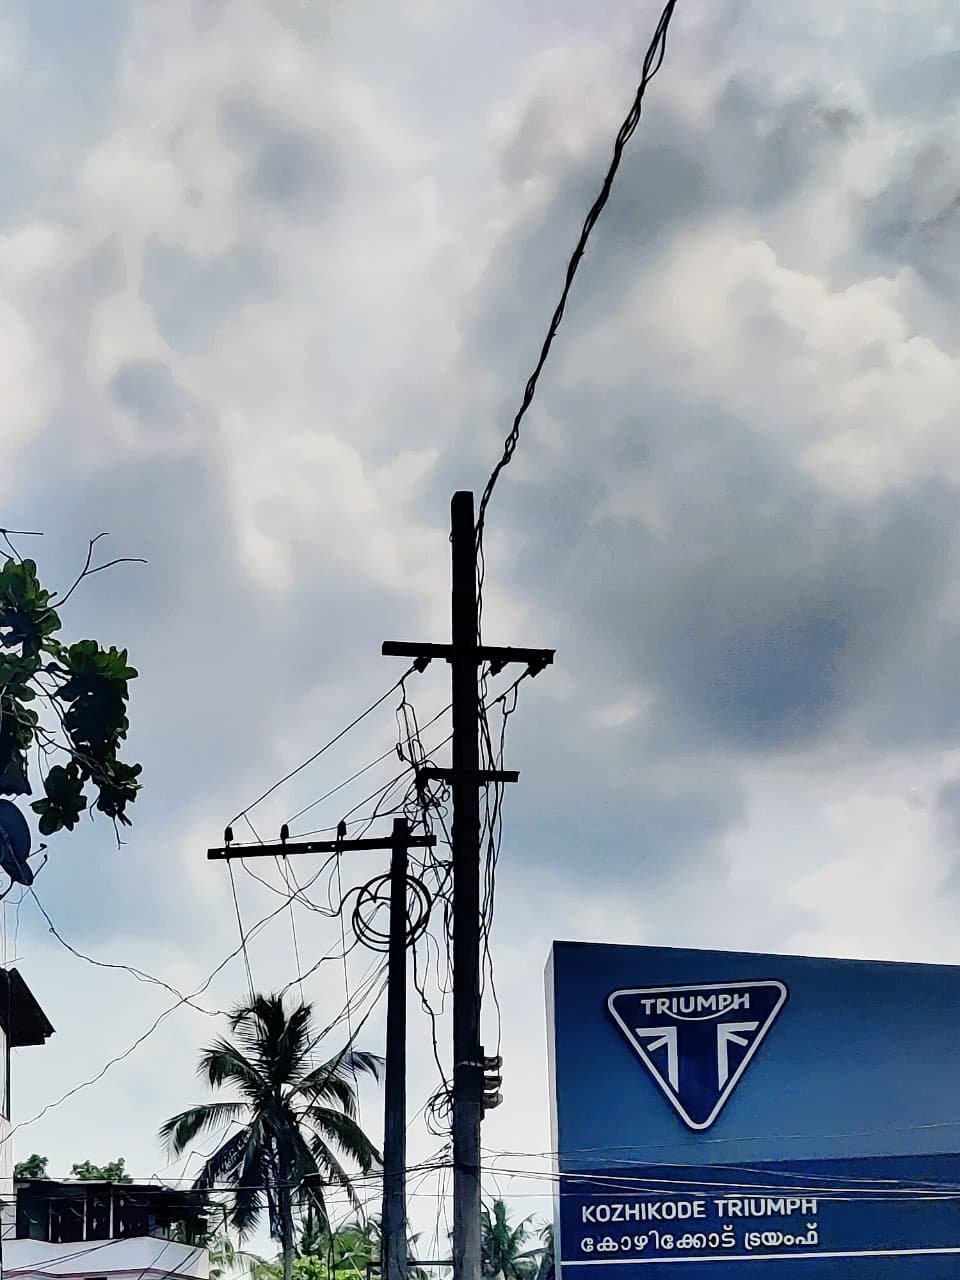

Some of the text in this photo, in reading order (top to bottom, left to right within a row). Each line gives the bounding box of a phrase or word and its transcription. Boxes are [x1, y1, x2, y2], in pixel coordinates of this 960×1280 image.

[640, 993, 750, 1020] TRIUMPH
[582, 1198, 818, 1223] KOZHIKODE TRIUMPH
[581, 1225, 736, 1253] കോഴിക്കോട്
